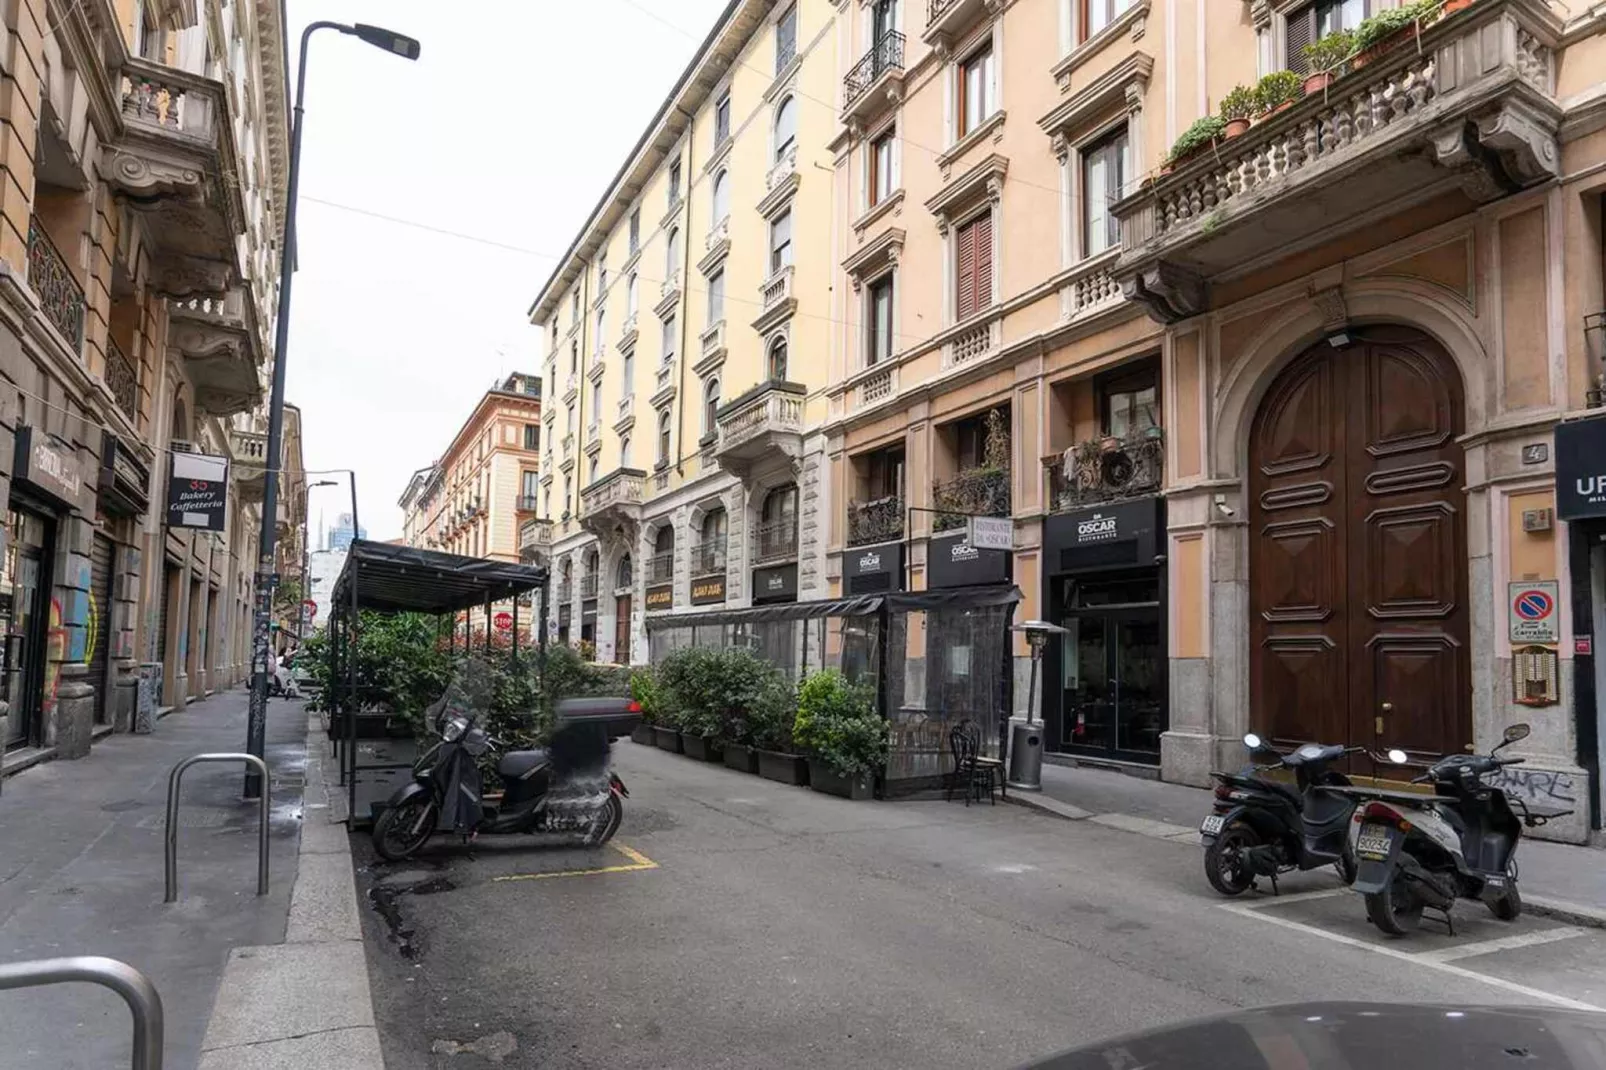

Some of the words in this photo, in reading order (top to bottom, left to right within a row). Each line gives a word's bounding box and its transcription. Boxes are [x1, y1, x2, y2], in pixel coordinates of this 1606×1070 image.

[179, 491, 215, 500] Bakery
[170, 501, 223, 511] Caffetteria
[1078, 520, 1116, 535] OSCAR
[859, 557, 881, 567] OSCAR
[494, 616, 512, 626] STOP
